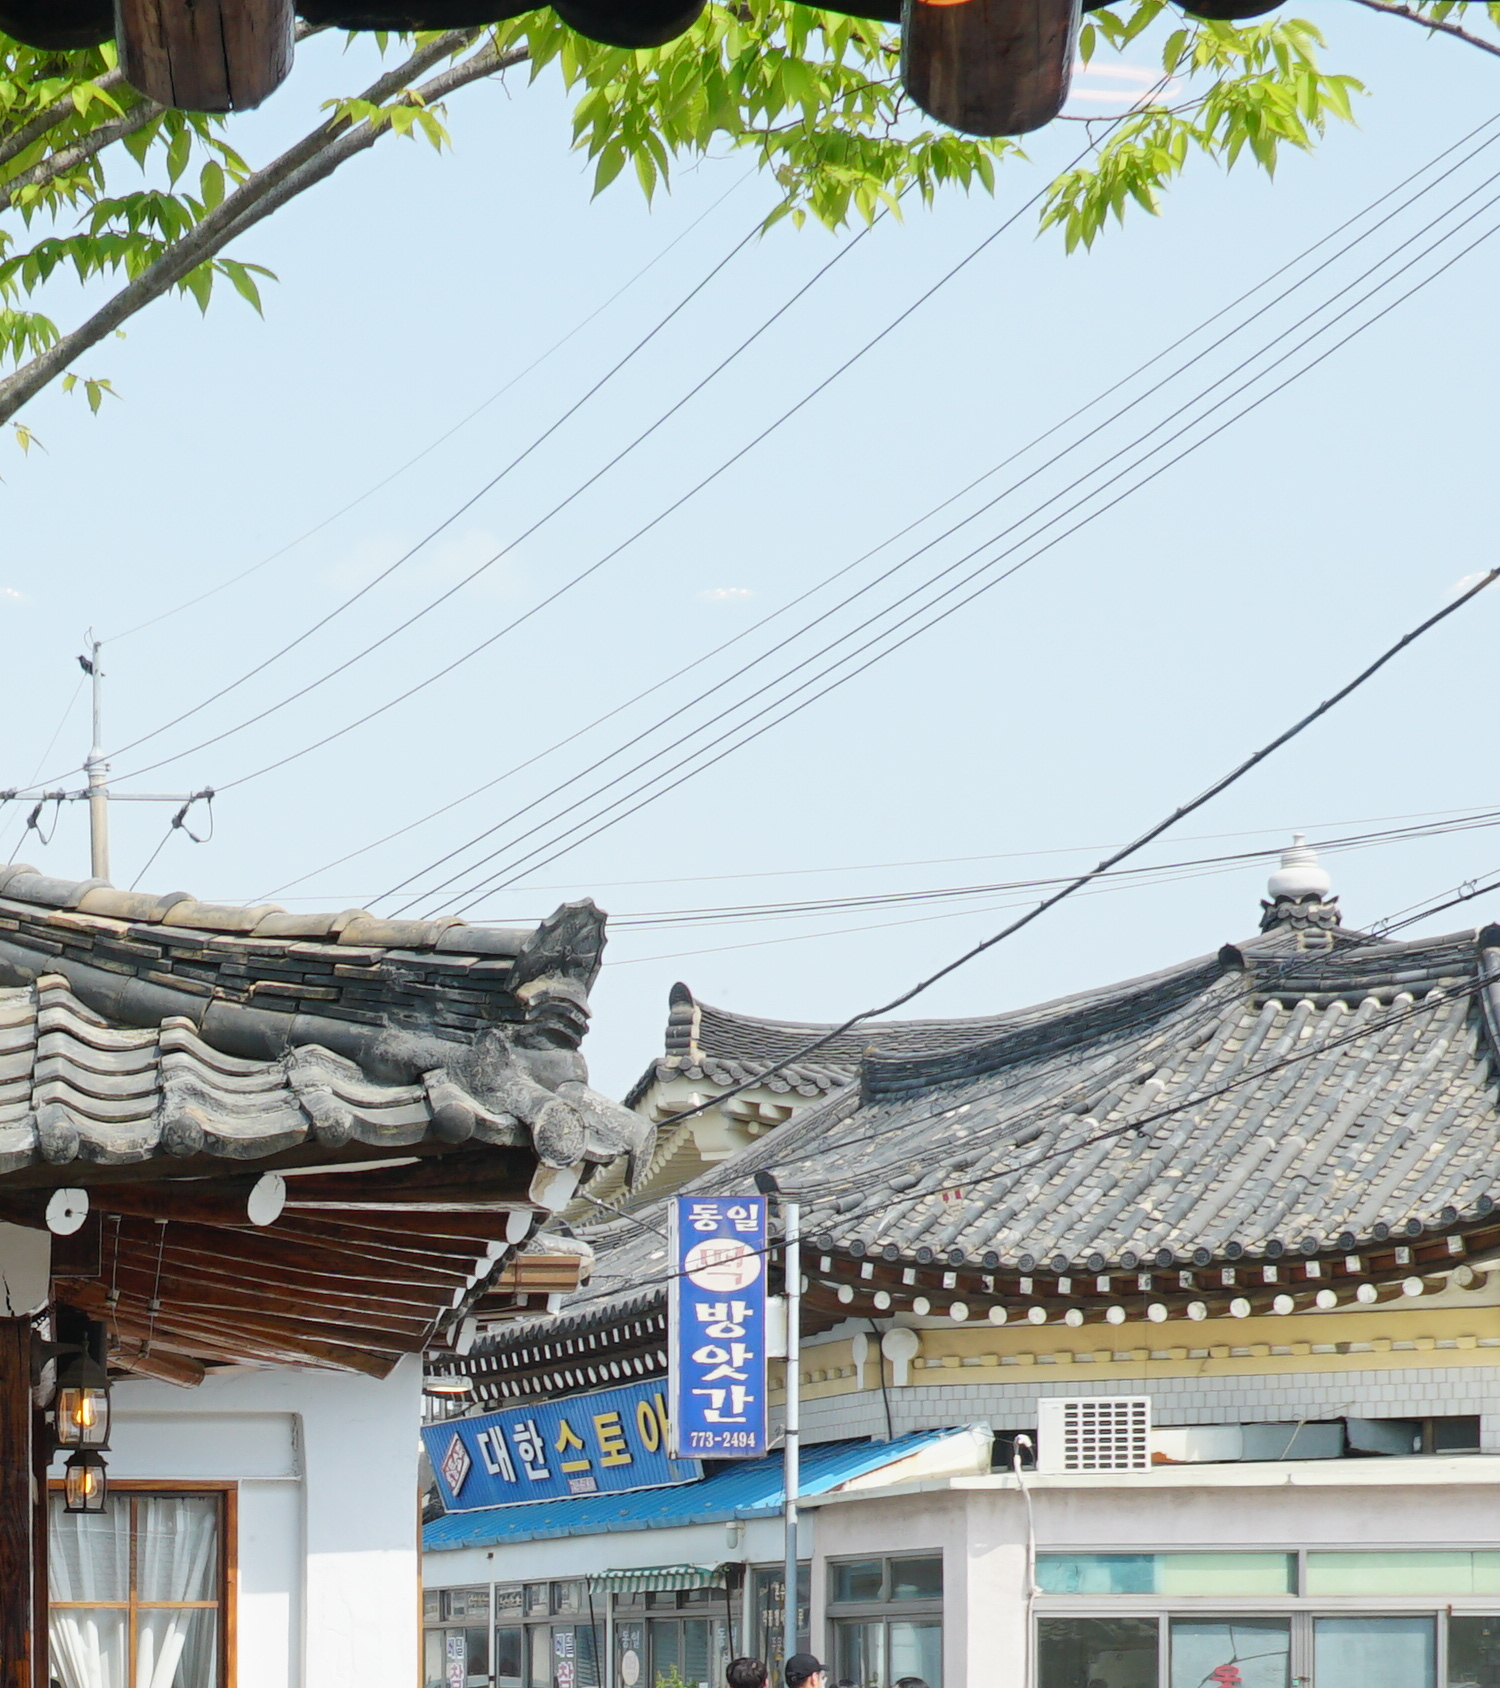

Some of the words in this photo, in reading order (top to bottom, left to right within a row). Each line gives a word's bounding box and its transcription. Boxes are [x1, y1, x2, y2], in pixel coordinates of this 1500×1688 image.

[688, 1203, 759, 1232] 동일
[692, 1300, 755, 1423] 방앗간
[690, 1431, 756, 1448] 773-2494
